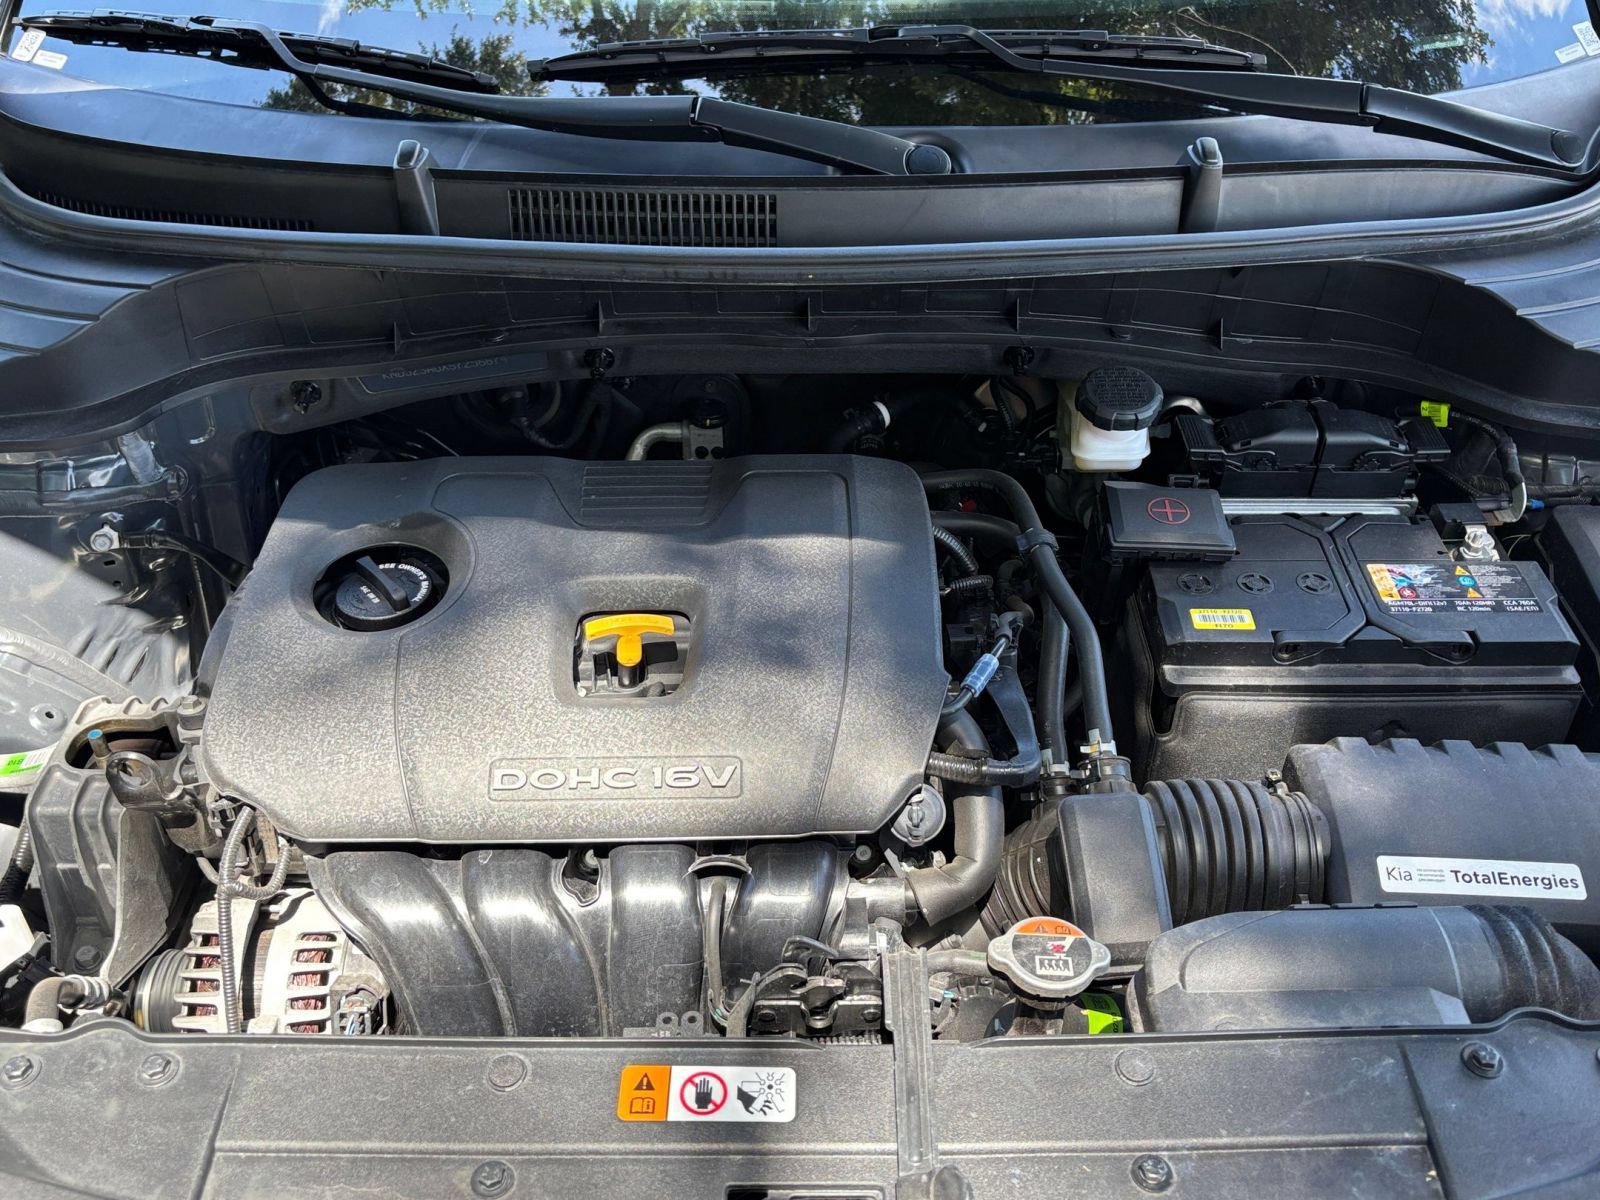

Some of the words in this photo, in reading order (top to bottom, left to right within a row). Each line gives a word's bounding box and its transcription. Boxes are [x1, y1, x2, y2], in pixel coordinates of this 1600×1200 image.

[492, 766, 639, 790] DOHC
[652, 765, 738, 789] 16V
[1386, 866, 1413, 882] Kia
[1450, 870, 1580, 890] TotalEnergies
